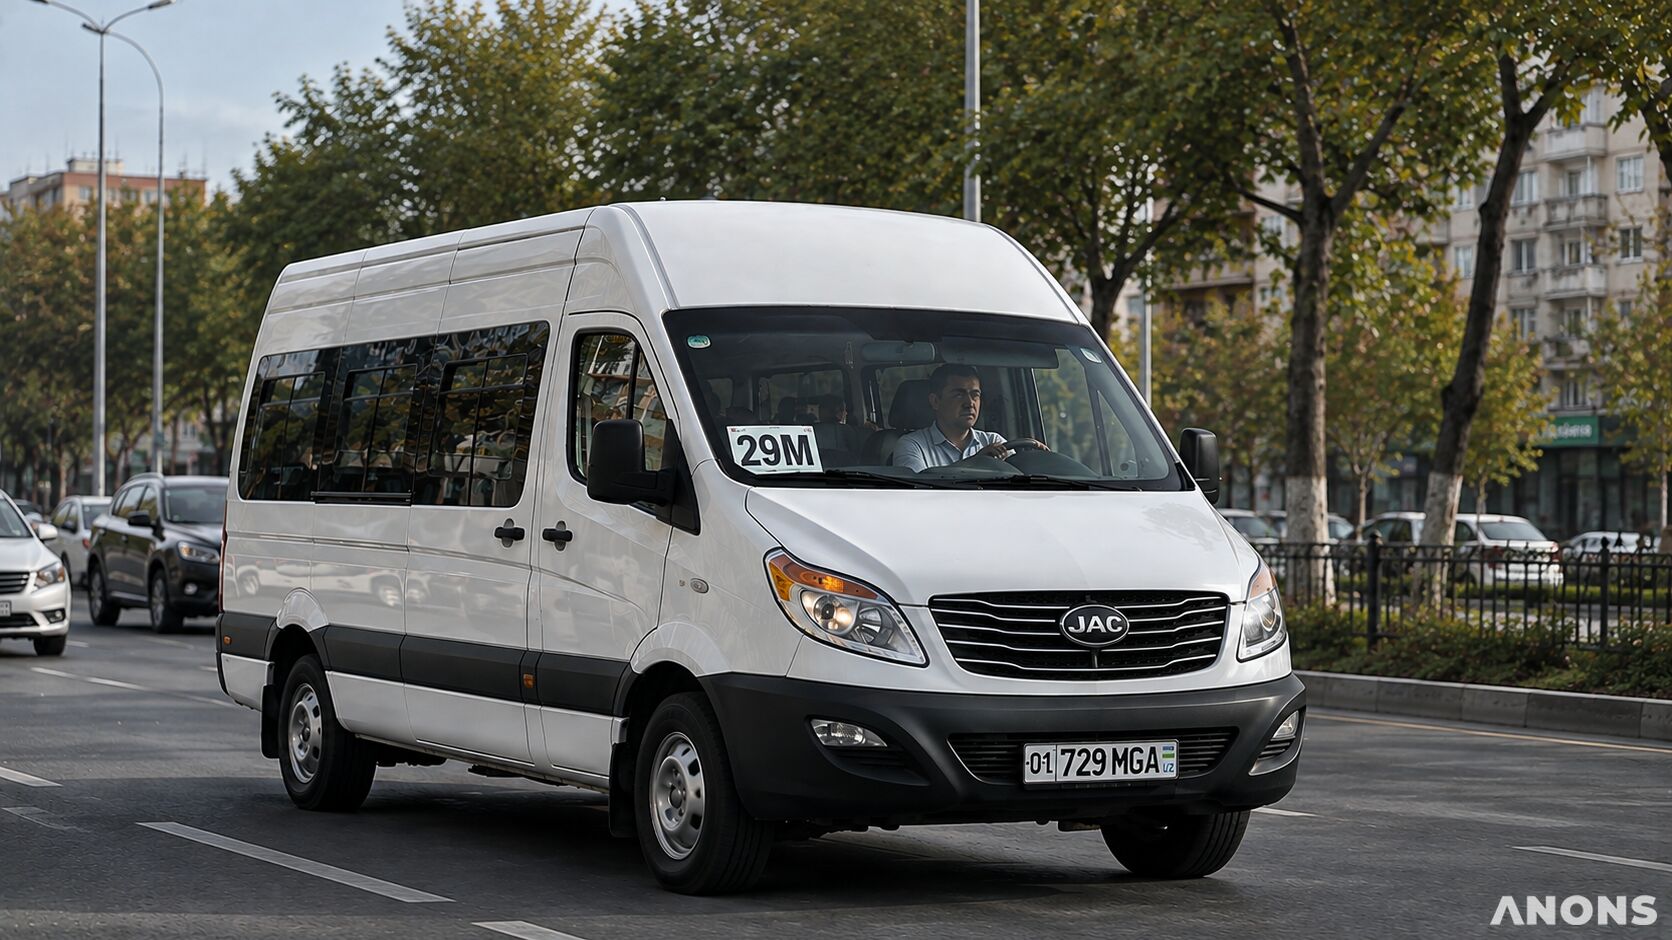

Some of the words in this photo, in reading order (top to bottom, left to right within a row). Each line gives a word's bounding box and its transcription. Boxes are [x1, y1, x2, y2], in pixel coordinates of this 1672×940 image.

[737, 434, 814, 466] 29M
[1068, 615, 1123, 633] JAC
[1060, 747, 1107, 777] 729
[1111, 746, 1160, 776] MGA
